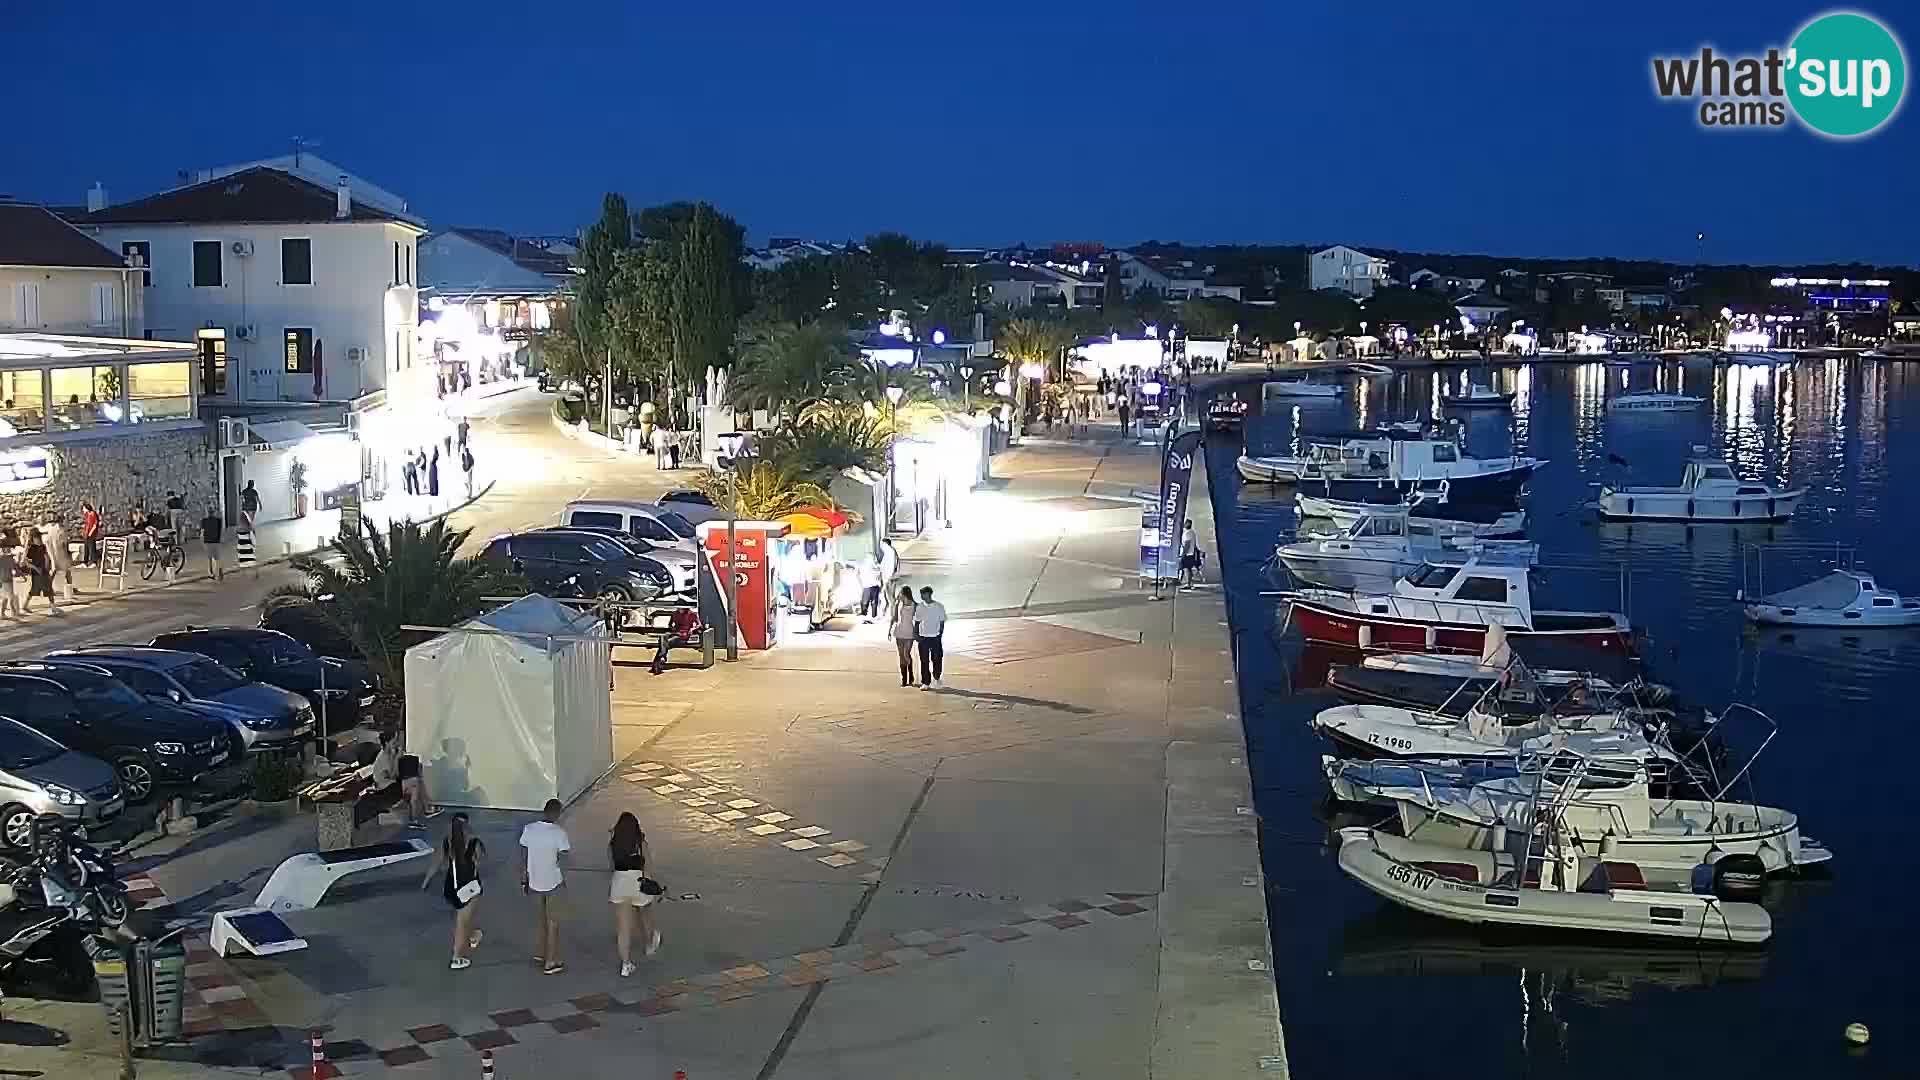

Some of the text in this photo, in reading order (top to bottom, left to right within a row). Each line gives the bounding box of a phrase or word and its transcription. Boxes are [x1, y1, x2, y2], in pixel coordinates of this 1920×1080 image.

[1166, 482, 1181, 514] Way
[719, 560, 759, 569] BAKOMAT
[1368, 733, 1412, 750] IZ 1980
[1387, 864, 1412, 883] 456
[1412, 872, 1434, 891] NV
